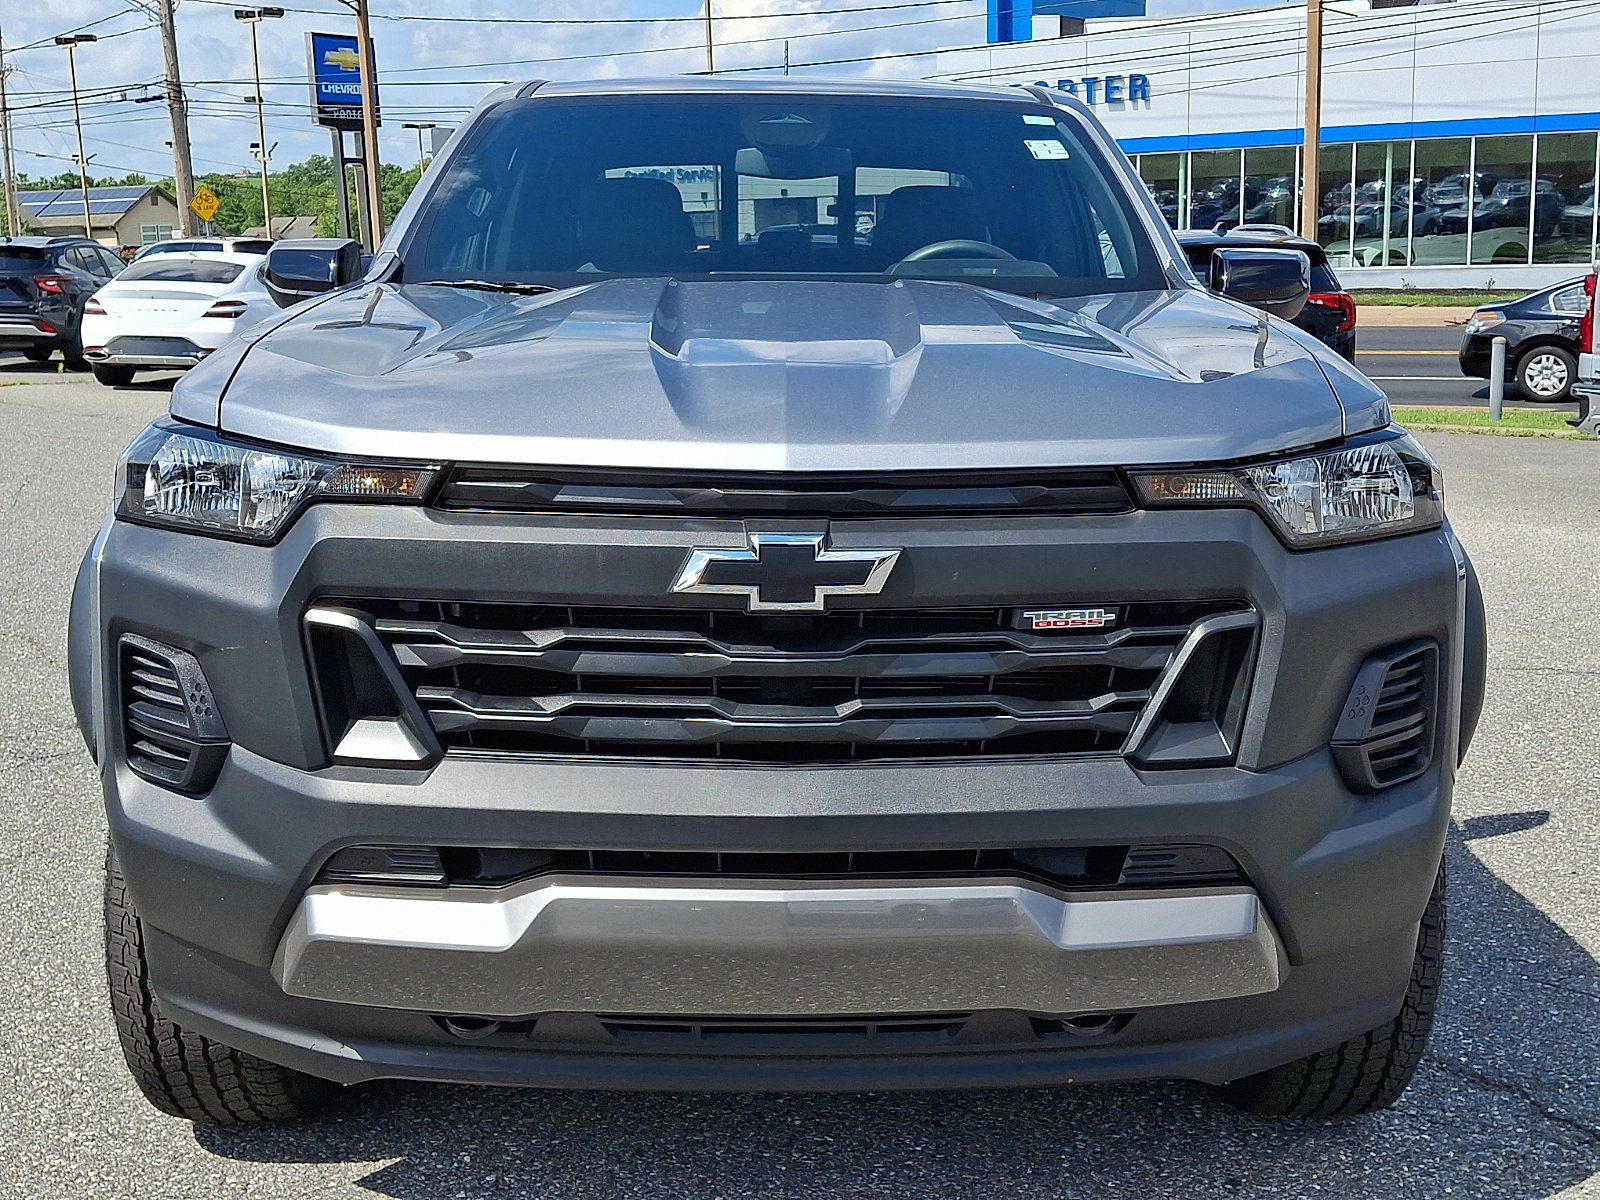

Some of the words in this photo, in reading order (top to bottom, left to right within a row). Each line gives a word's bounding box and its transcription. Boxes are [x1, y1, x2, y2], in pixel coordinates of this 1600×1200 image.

[321, 82, 362, 95] CHEVRO
[1008, 74, 1149, 105] RTER
[1023, 608, 1116, 620] TRAIL
[1033, 619, 1105, 629] BOSS
